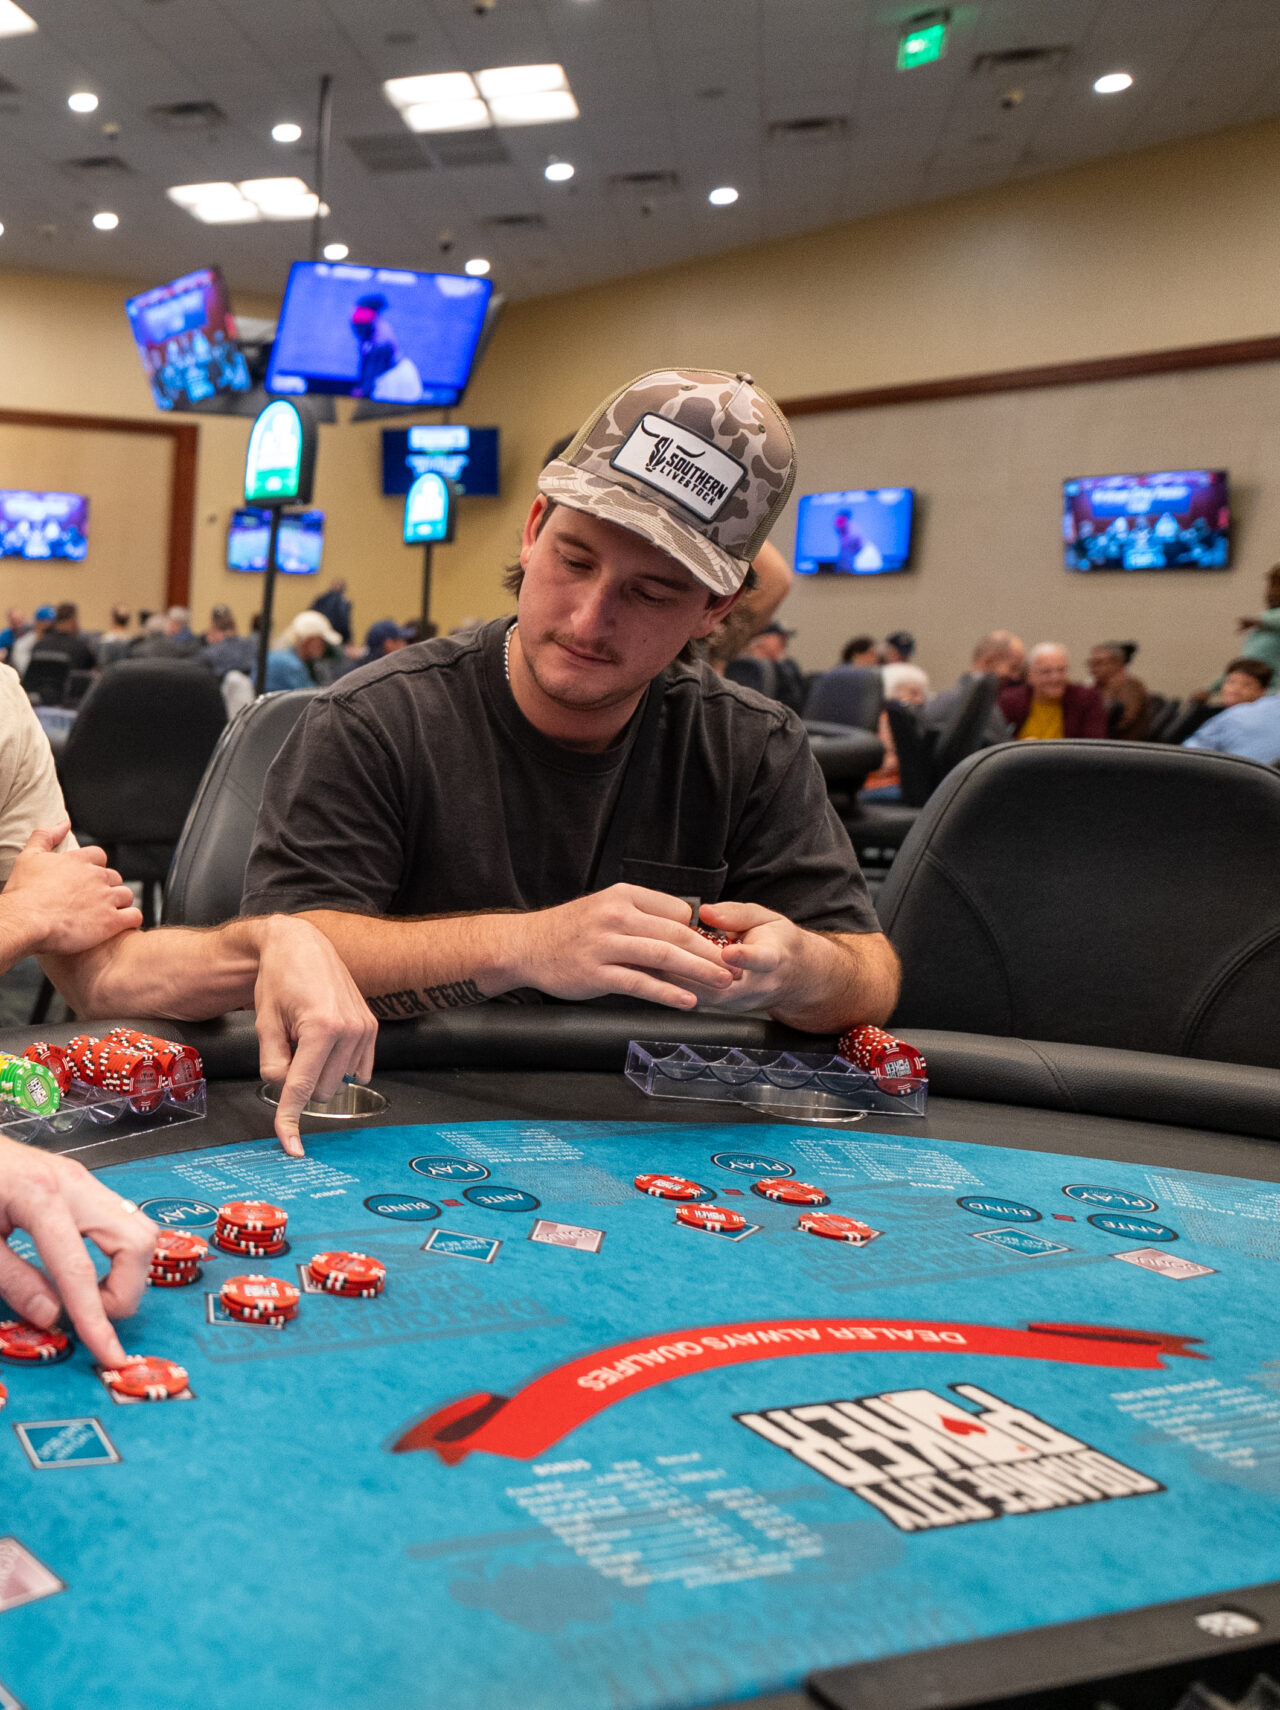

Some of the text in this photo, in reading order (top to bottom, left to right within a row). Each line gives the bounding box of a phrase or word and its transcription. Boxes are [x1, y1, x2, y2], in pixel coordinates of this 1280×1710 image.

[665, 452, 728, 500] SOUTHERN
[659, 466, 716, 506] LIVESTOCK
[428, 1163, 480, 1176] PLAY
[728, 1160, 785, 1172] PLAY
[477, 1192, 524, 1205] ANTE
[1079, 1190, 1151, 1209] PLAY
[158, 1203, 210, 1225] PLAY
[377, 1202, 431, 1215] BLIND
[968, 1202, 1033, 1217] BLIND
[1102, 1220, 1164, 1235] ANTE
[576, 1327, 968, 1392] DEALER ALWAYS QUALIFIES
[852, 1450, 1160, 1530] ORANGE CITY
